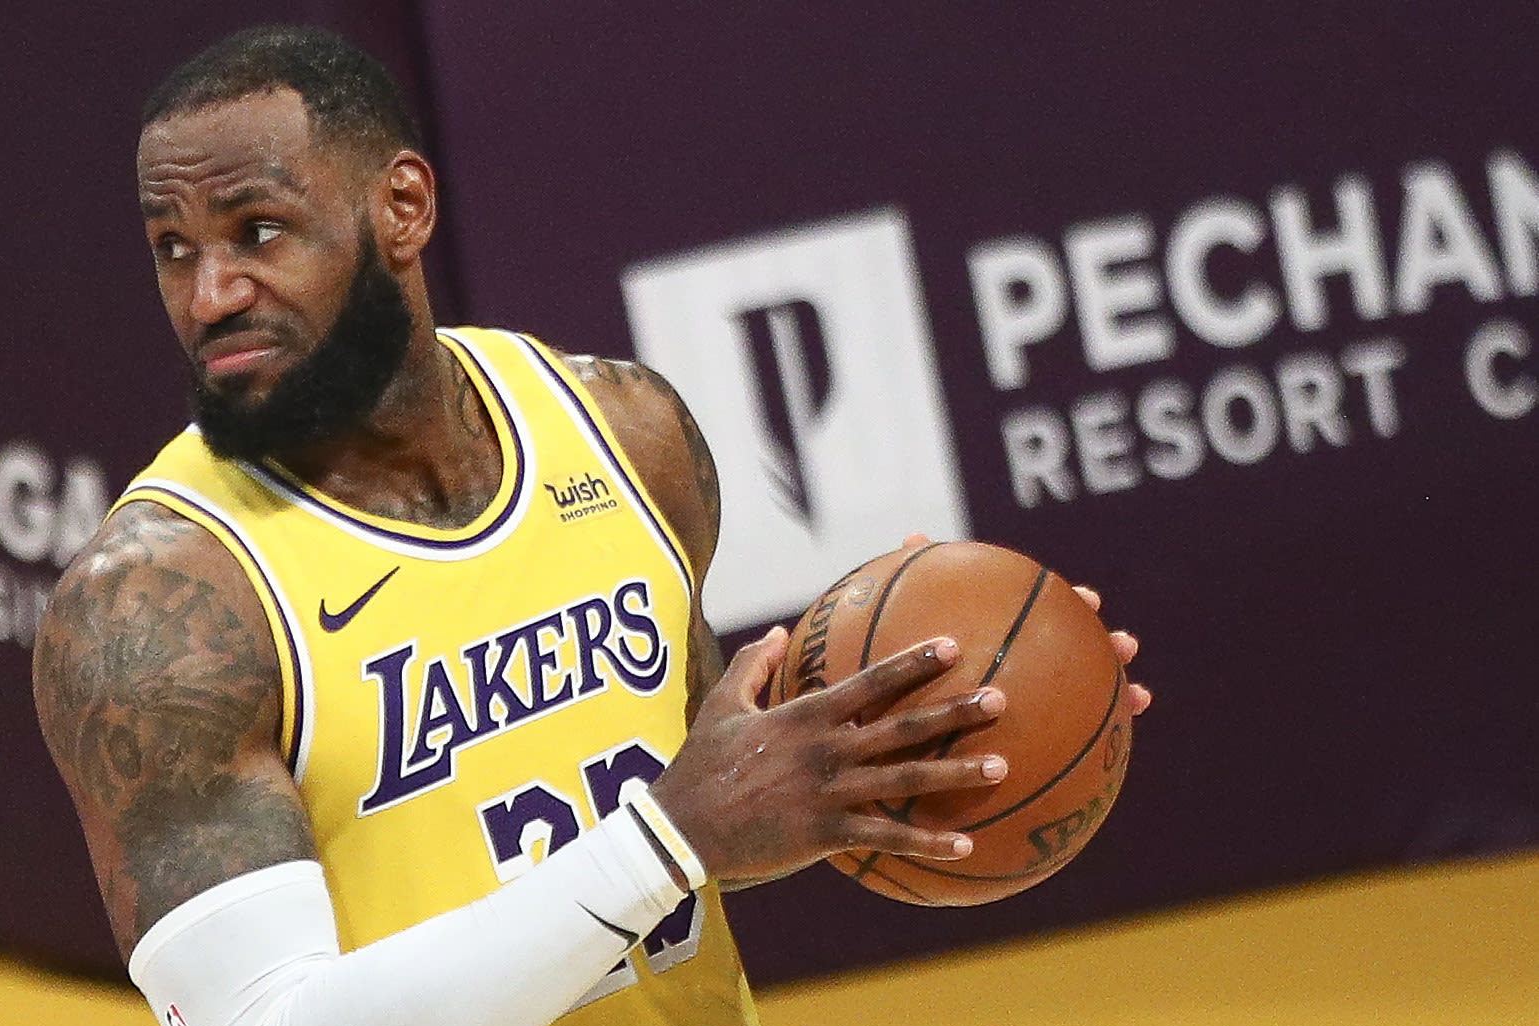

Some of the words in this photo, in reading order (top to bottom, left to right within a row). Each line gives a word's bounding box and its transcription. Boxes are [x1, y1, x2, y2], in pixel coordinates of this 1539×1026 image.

[543, 472, 610, 508] wish
[1000, 336, 1406, 510] RESORT
[358, 577, 671, 818] LAKERS
